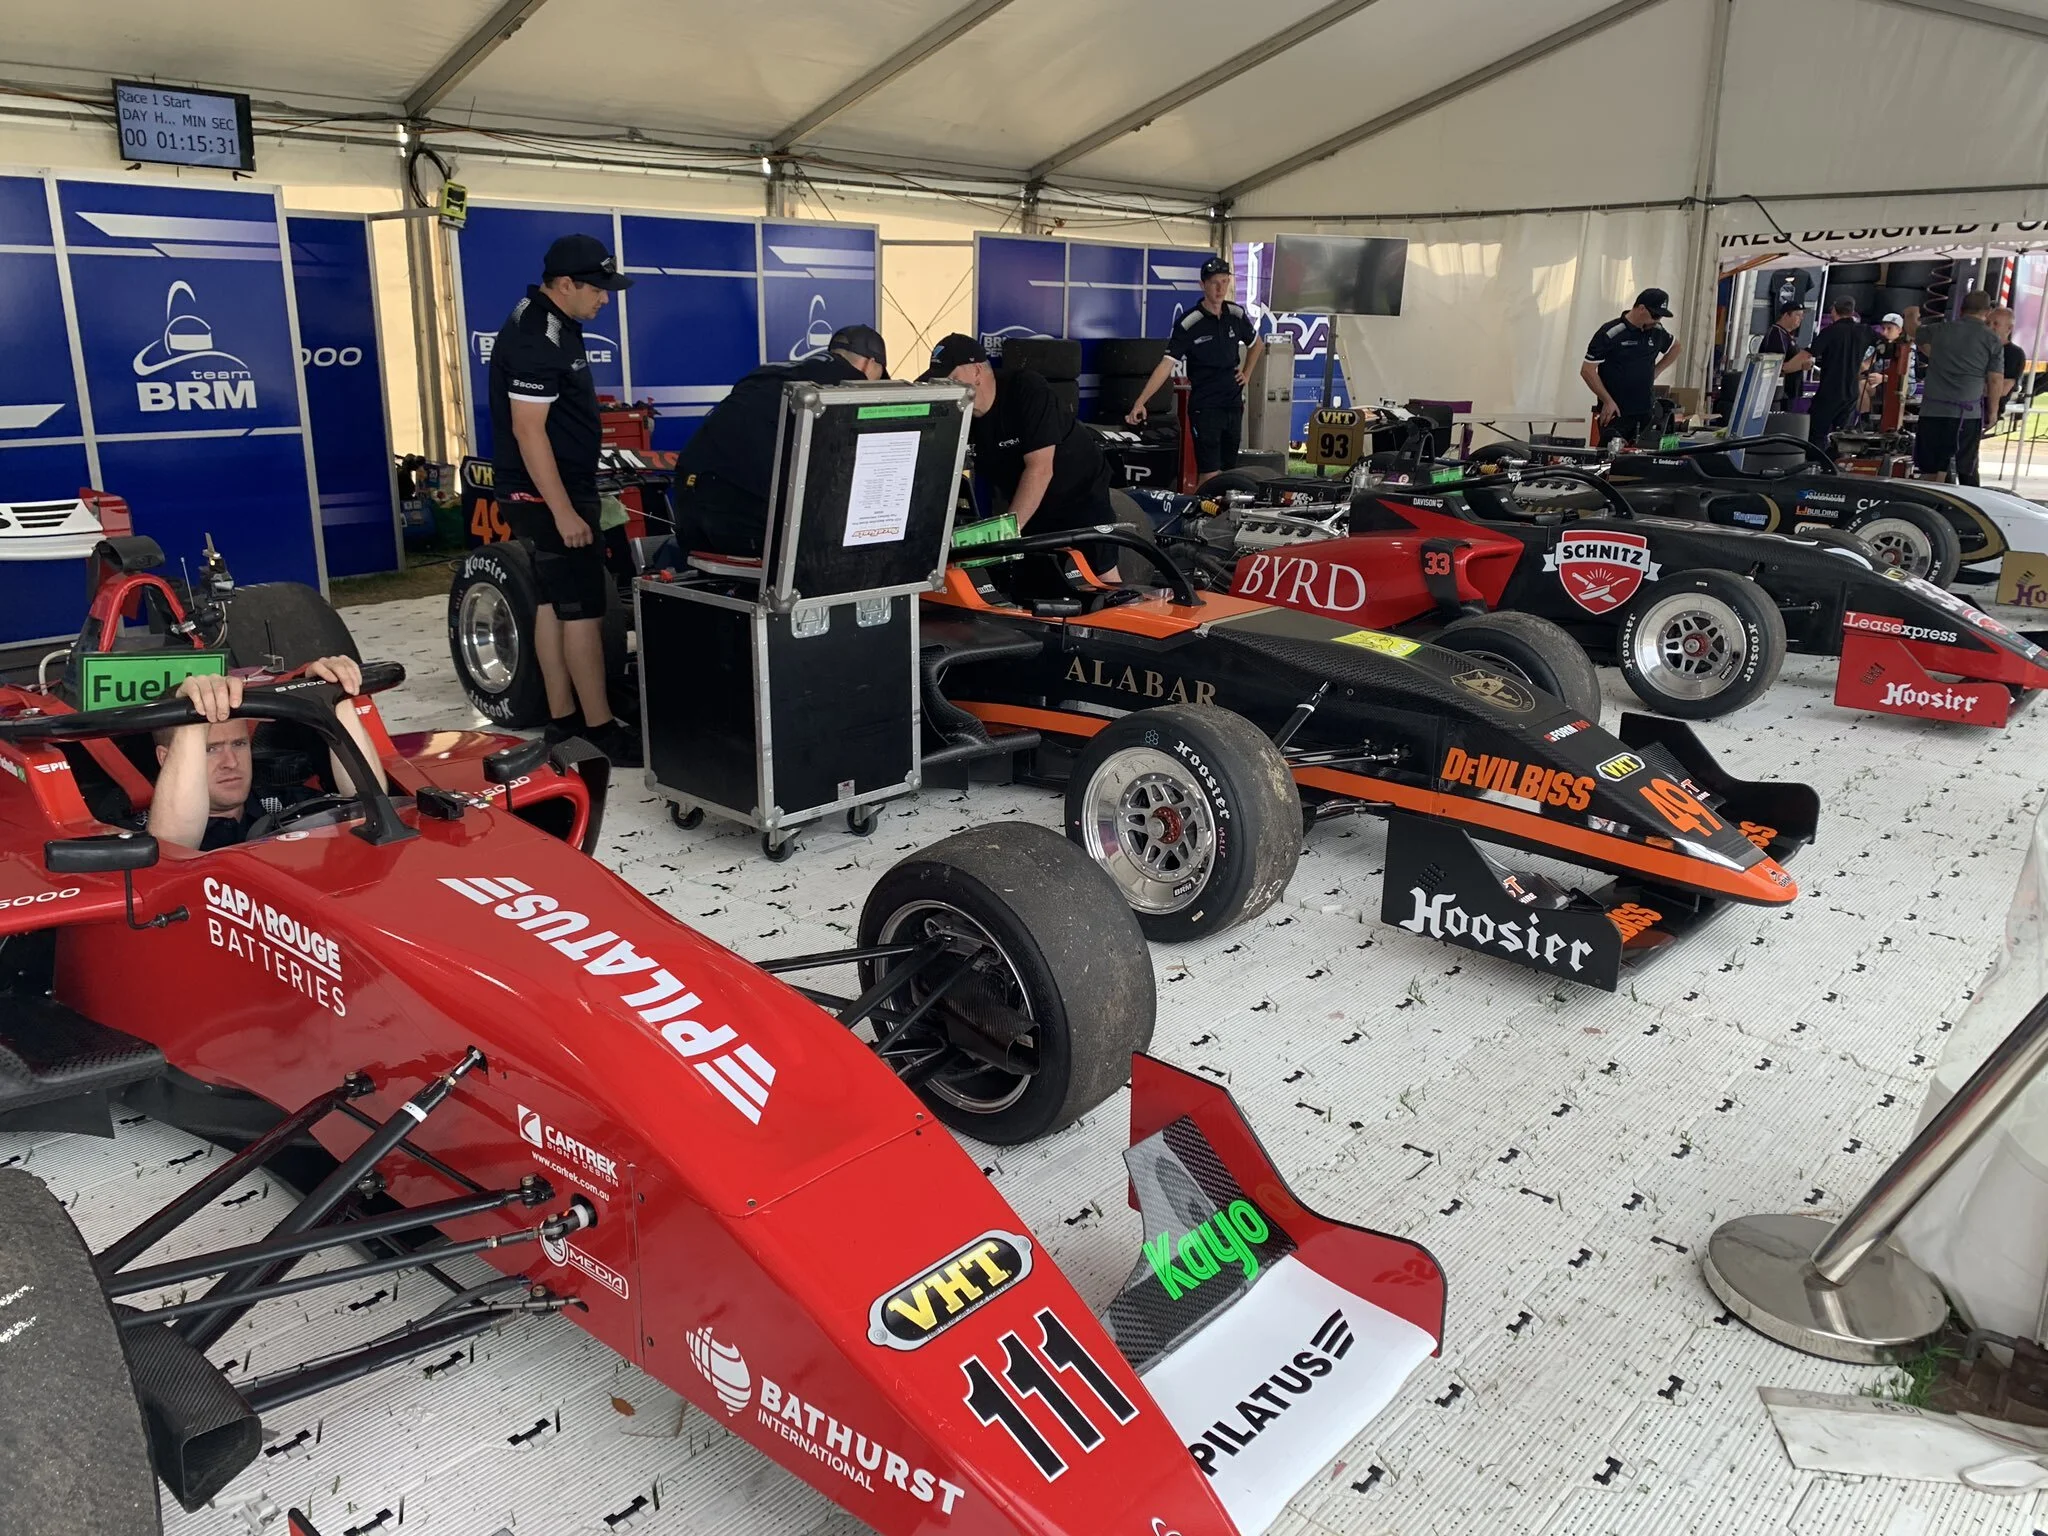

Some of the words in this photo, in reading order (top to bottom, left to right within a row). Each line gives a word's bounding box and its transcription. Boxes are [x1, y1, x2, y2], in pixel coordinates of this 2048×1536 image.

[118, 89, 148, 104] Race
[153, 94, 158, 105] 1
[163, 95, 191, 109] Start
[122, 108, 147, 121] DAY
[183, 114, 206, 128] MIN
[212, 117, 235, 131] SEC
[125, 128, 147, 147] 00
[157, 131, 236, 154] 01:15:31
[1802, 224, 1980, 242] DESIGNED
[136, 380, 257, 412] BRM
[191, 370, 250, 379] team
[513, 379, 544, 390] S5000
[1322, 411, 1353, 424] VHT
[1320, 433, 1349, 459] 93
[471, 464, 495, 485] VH
[1413, 498, 1436, 507] DAVISON
[1808, 508, 1838, 517] BUILDING
[464, 555, 507, 584] Hoosier
[1424, 552, 1450, 575] 33
[1563, 542, 1643, 566] SCHNITZ
[1239, 554, 1367, 612] BYRD
[1622, 613, 1636, 669] Hoosier
[1843, 612, 1958, 643] Leasexpress
[1743, 622, 1760, 682] Hoosier
[1065, 659, 1217, 707] ALABAR
[1879, 682, 1978, 714] Hoosier
[1174, 740, 1230, 820] Hoosier
[1441, 747, 1596, 811] DeVILBISS
[1601, 756, 1639, 778] VHT
[1639, 778, 1723, 837] 49
[1399, 886, 1593, 972] Hoosier
[208, 917, 346, 1017] BATTERIES
[494, 893, 738, 1058] PILATUS
[545, 1125, 618, 1179] CARTREK
[546, 1142, 570, 1159] SIGN
[582, 1163, 619, 1187] DESIGN
[532, 1151, 610, 1201] www.cartrek.com.au
[569, 1249, 622, 1290] MEDIA
[1142, 1200, 1269, 1300] Kayo
[887, 1241, 1009, 1331] VHT
[960, 1307, 1139, 1480] 111
[1187, 1352, 1333, 1477] PILATUS
[757, 1408, 875, 1494] INTERNATIONAL
[760, 1376, 965, 1515] BATHURST
